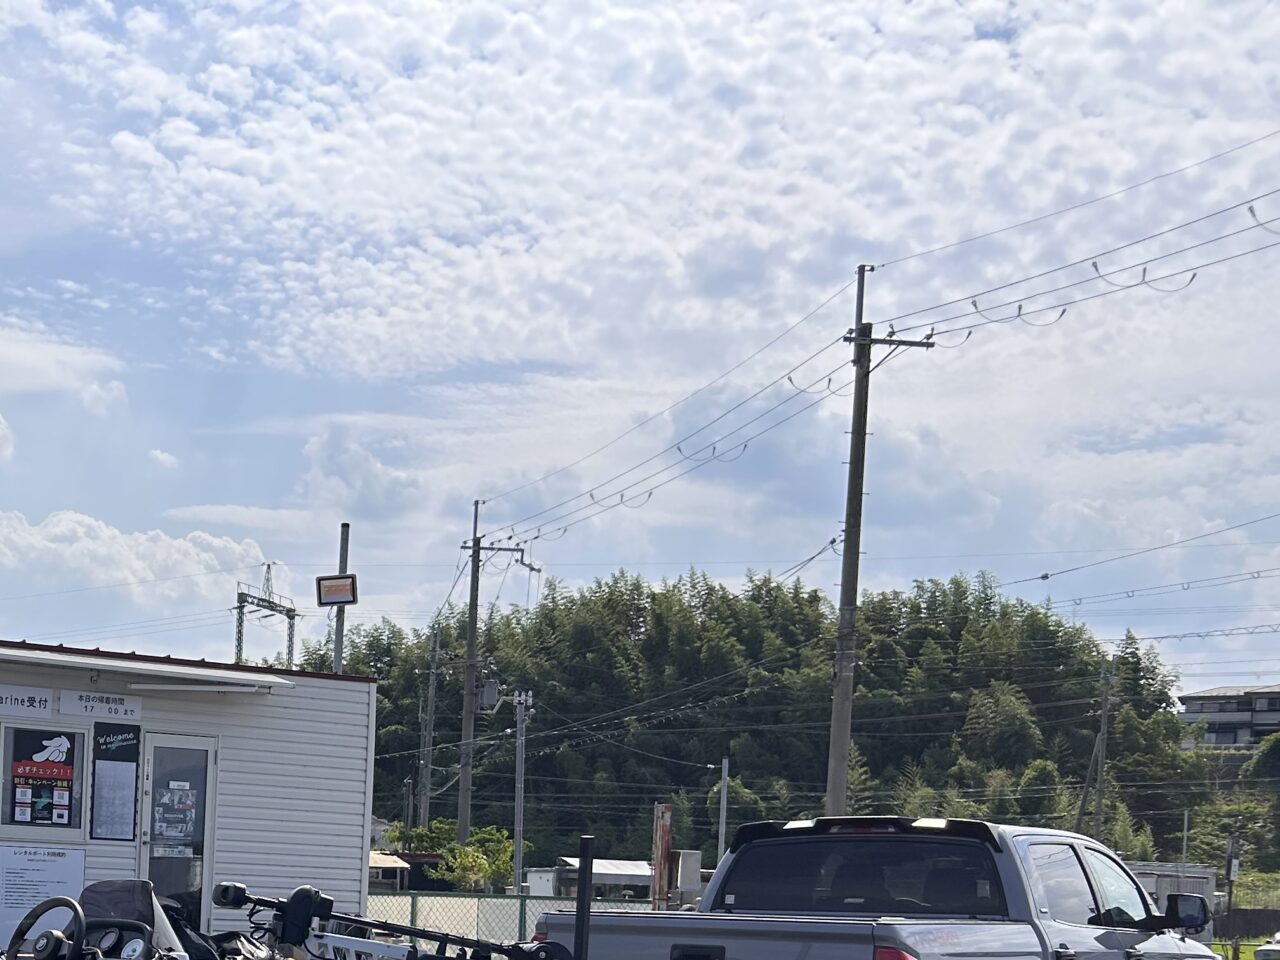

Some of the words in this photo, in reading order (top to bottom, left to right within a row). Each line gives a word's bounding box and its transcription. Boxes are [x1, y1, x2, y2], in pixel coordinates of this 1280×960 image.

[84, 705, 95, 713] 17
[108, 707, 119, 715] 00
[96, 732, 135, 744] Welcome
